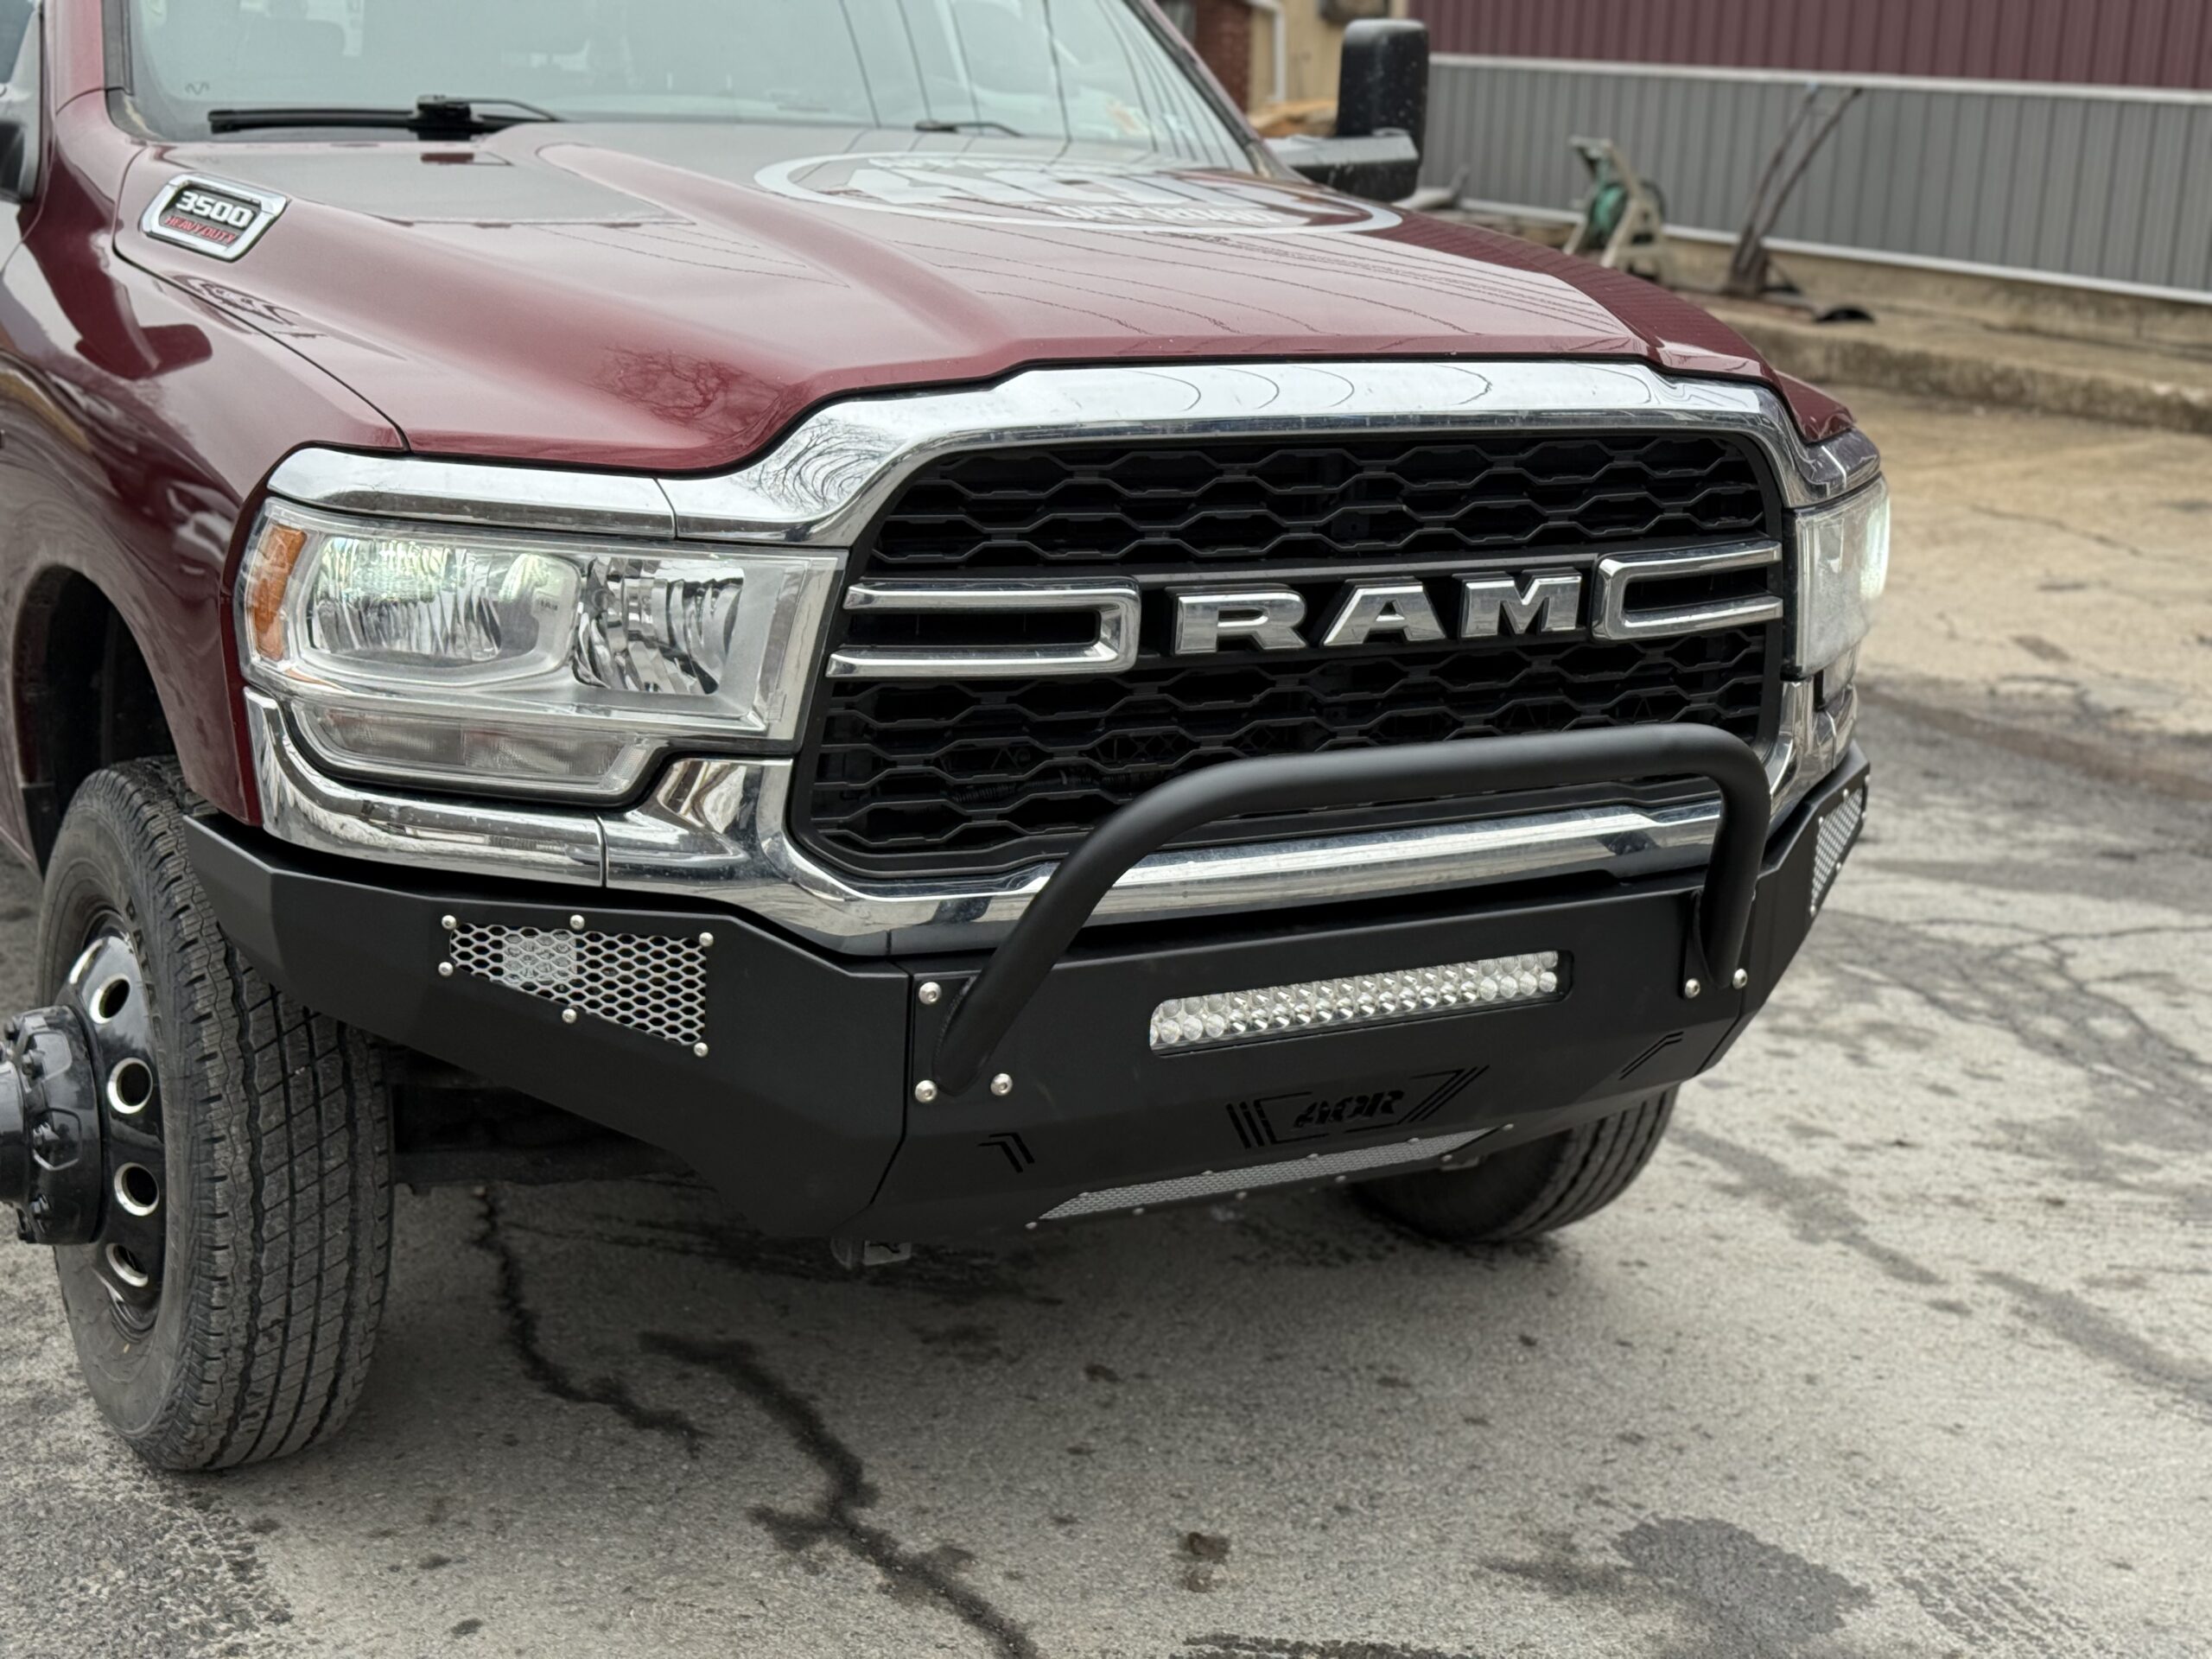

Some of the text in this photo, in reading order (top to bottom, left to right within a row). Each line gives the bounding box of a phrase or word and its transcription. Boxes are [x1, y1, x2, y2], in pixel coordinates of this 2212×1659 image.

[175, 190, 255, 228] 3500
[163, 215, 237, 245] HEAVY DUTY
[1172, 570, 1584, 656] RAM
